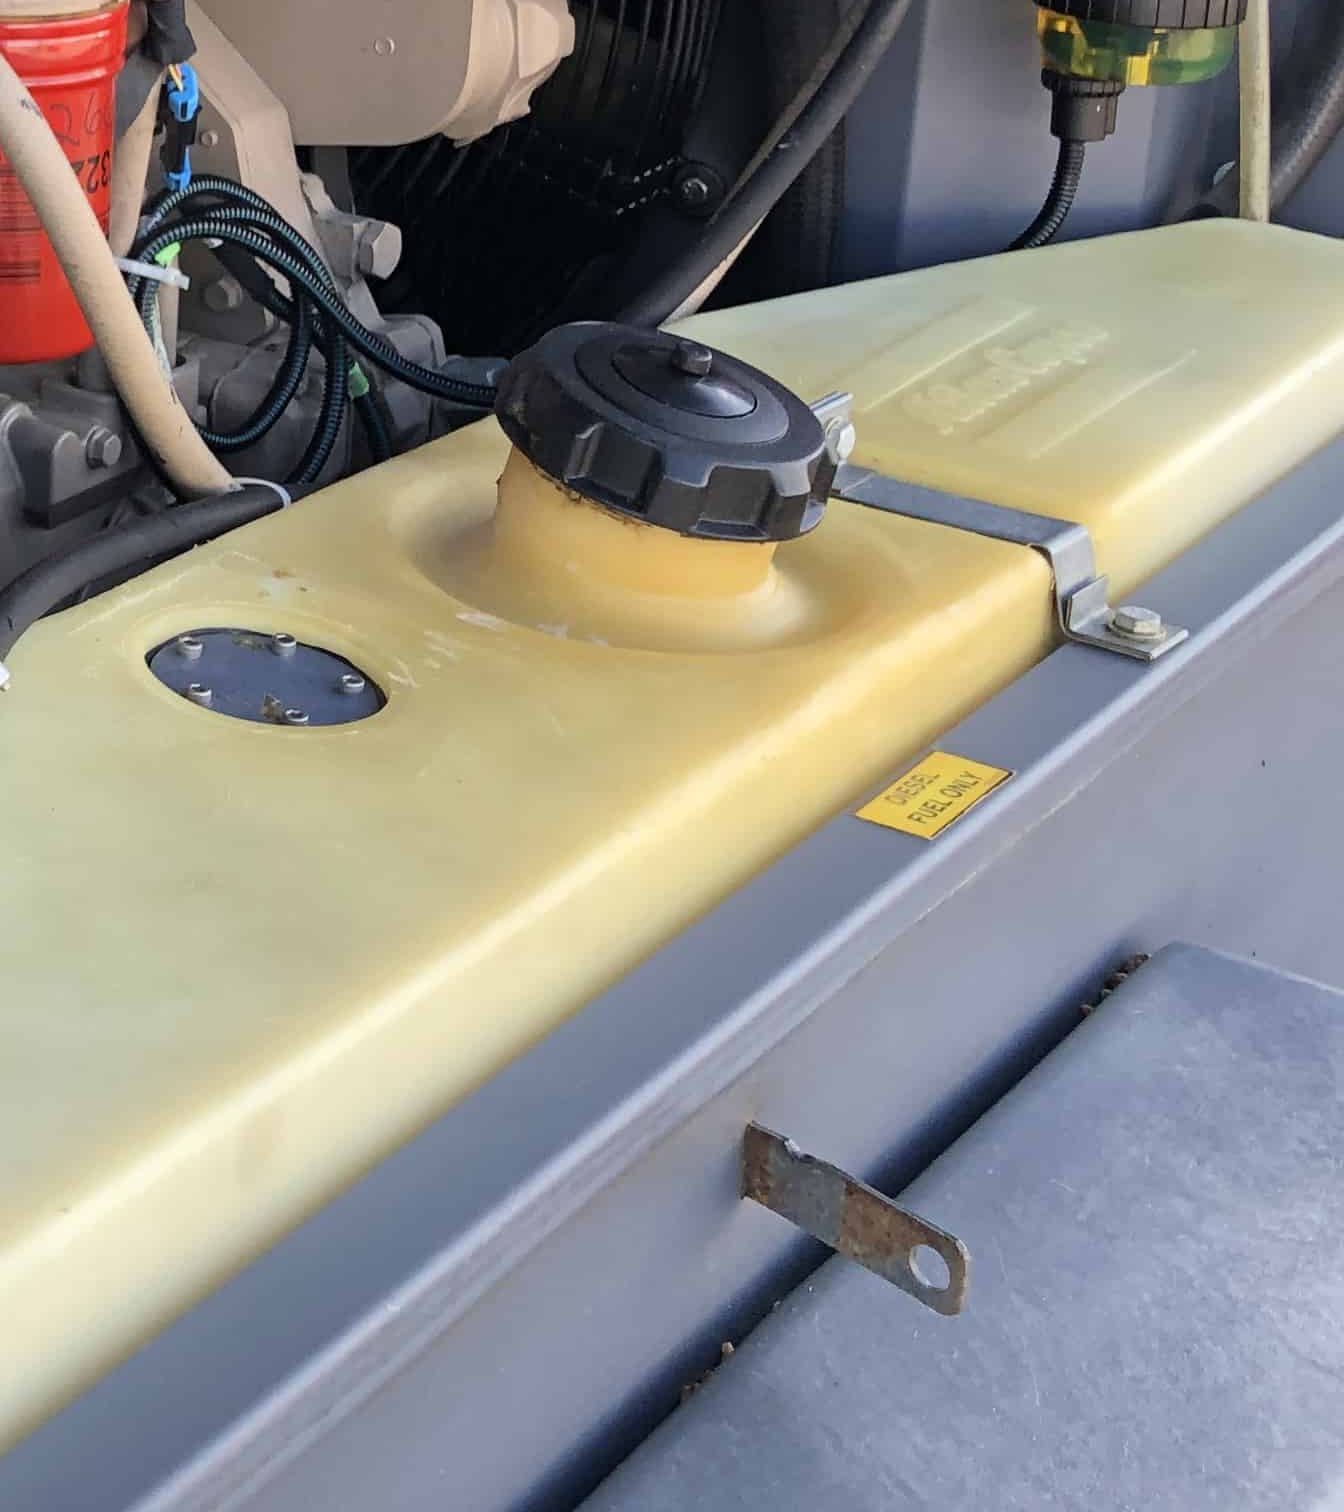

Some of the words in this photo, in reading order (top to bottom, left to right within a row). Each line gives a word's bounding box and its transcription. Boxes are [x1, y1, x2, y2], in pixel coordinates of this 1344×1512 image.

[883, 771, 942, 807] DIESEL
[906, 800, 953, 824] FUEL
[940, 769, 984, 800] ONLY
